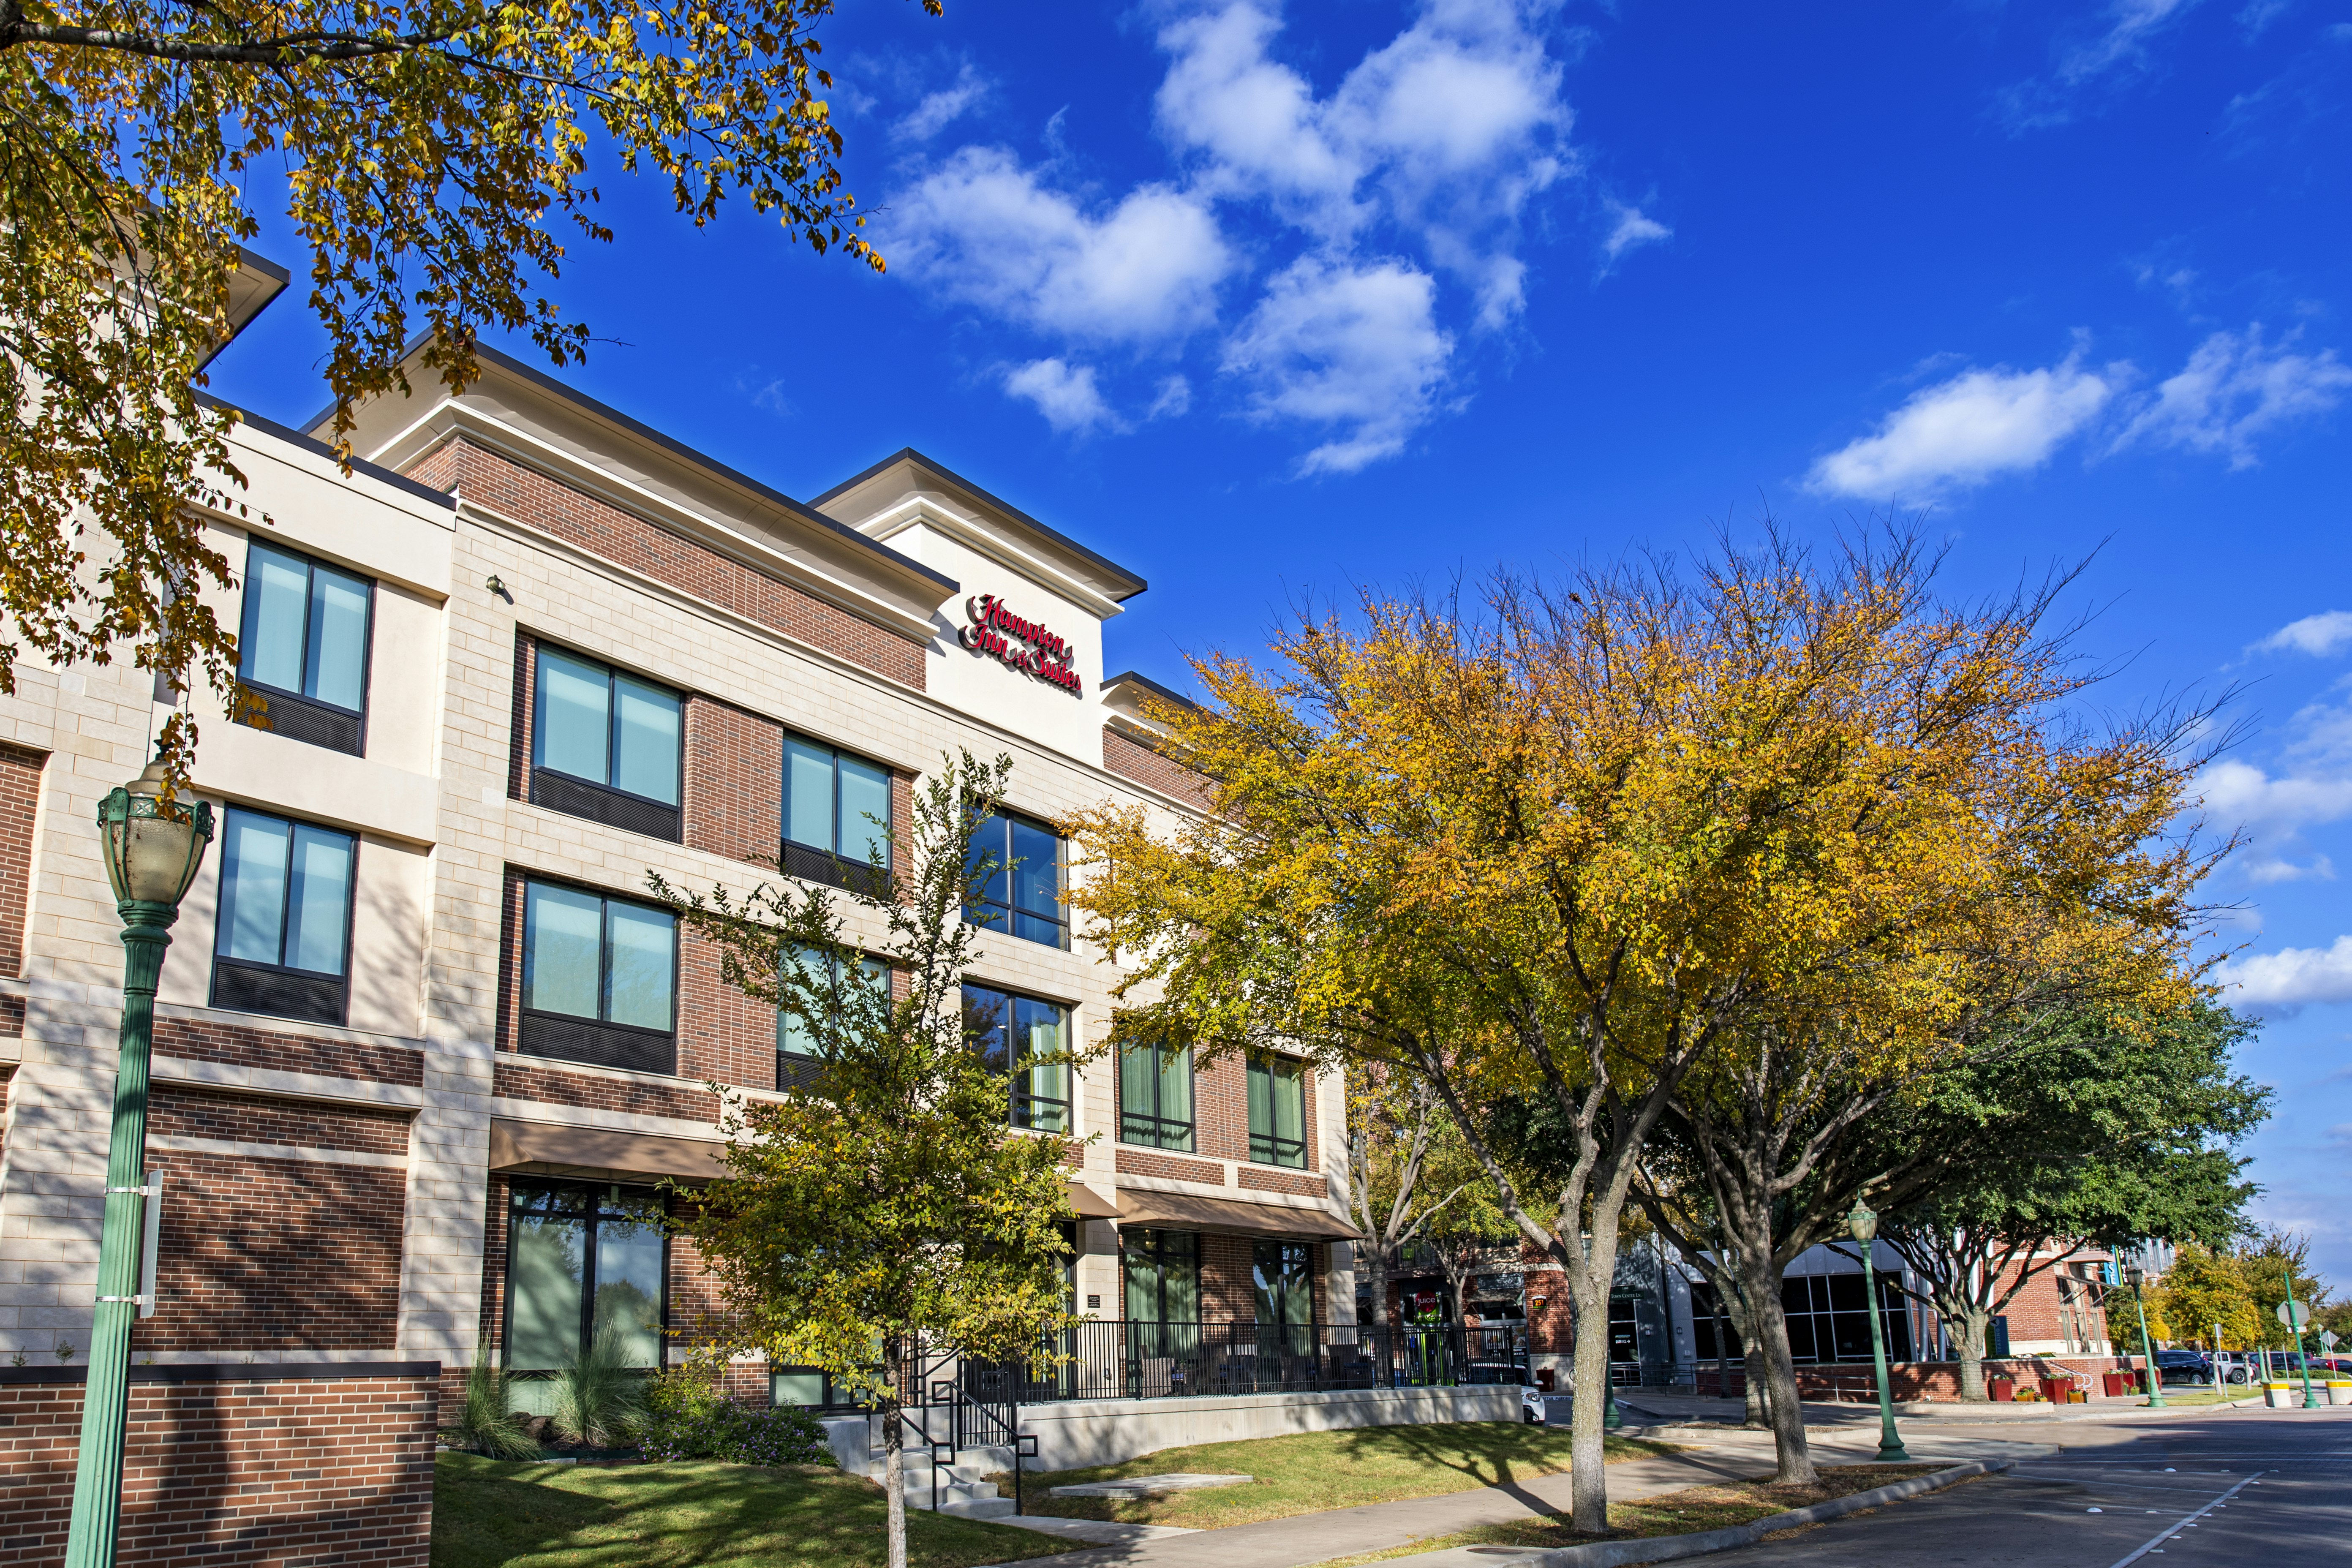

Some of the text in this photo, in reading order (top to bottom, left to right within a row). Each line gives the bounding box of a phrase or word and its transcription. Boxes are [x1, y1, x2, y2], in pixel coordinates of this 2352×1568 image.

[966, 594, 1073, 661] Hampton
[958, 623, 1081, 692] Inn & Suites
[1413, 1315, 1441, 1325] junkies
[1418, 1297, 1435, 1307] juice
